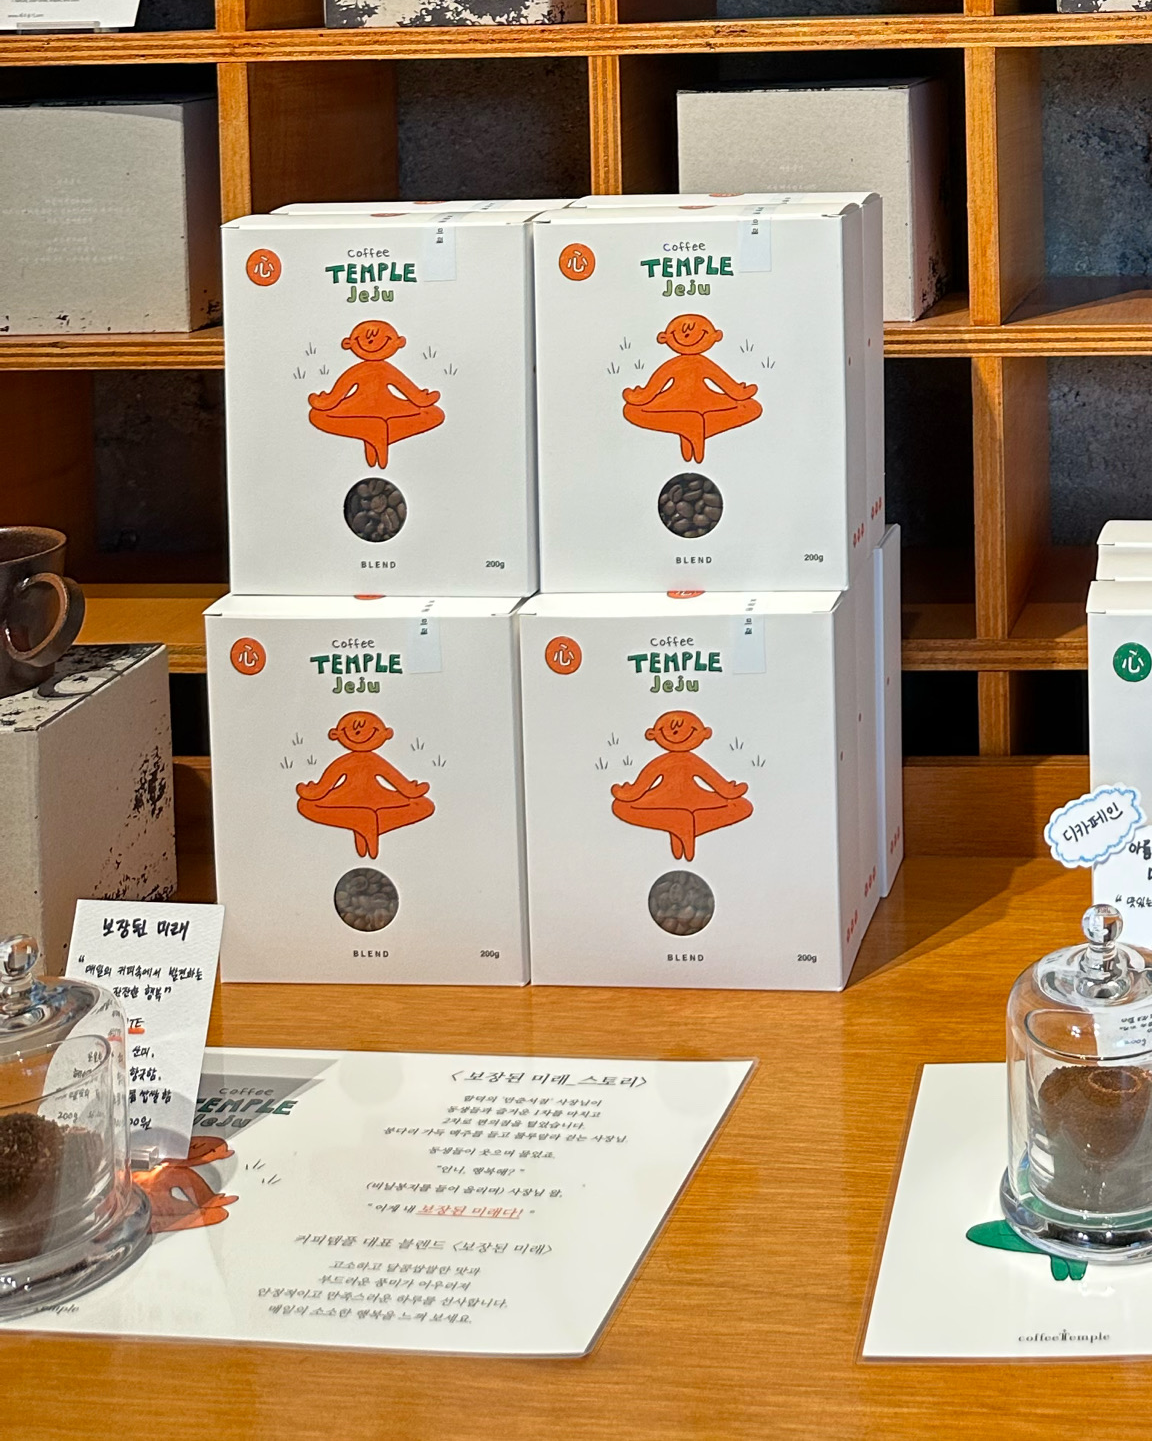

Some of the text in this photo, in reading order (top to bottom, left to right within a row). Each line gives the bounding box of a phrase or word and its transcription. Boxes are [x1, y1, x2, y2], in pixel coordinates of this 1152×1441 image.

[325, 262, 417, 284] TEMPLE
[640, 255, 734, 278] TEMPLE
[346, 286, 394, 303] Jeju
[662, 279, 710, 297] Jeju
[361, 561, 396, 569] BLEND
[486, 561, 505, 569] 200g
[804, 554, 823, 562] 200g
[310, 653, 403, 674] TEMPLE
[627, 651, 722, 673] TEMPLE
[332, 677, 380, 694] Jeju
[650, 675, 699, 693] Jeju
[1062, 801, 1124, 843] 디카페인
[103, 918, 189, 941] 보장된 미래
[480, 950, 499, 959] 200g
[798, 954, 817, 963] 200g
[85, 964, 112, 978] 매일의
[464, 1071, 526, 1084] 보장된
[294, 1233, 553, 1256] 커피템플 대표 블렌드 <보장된 미래>
